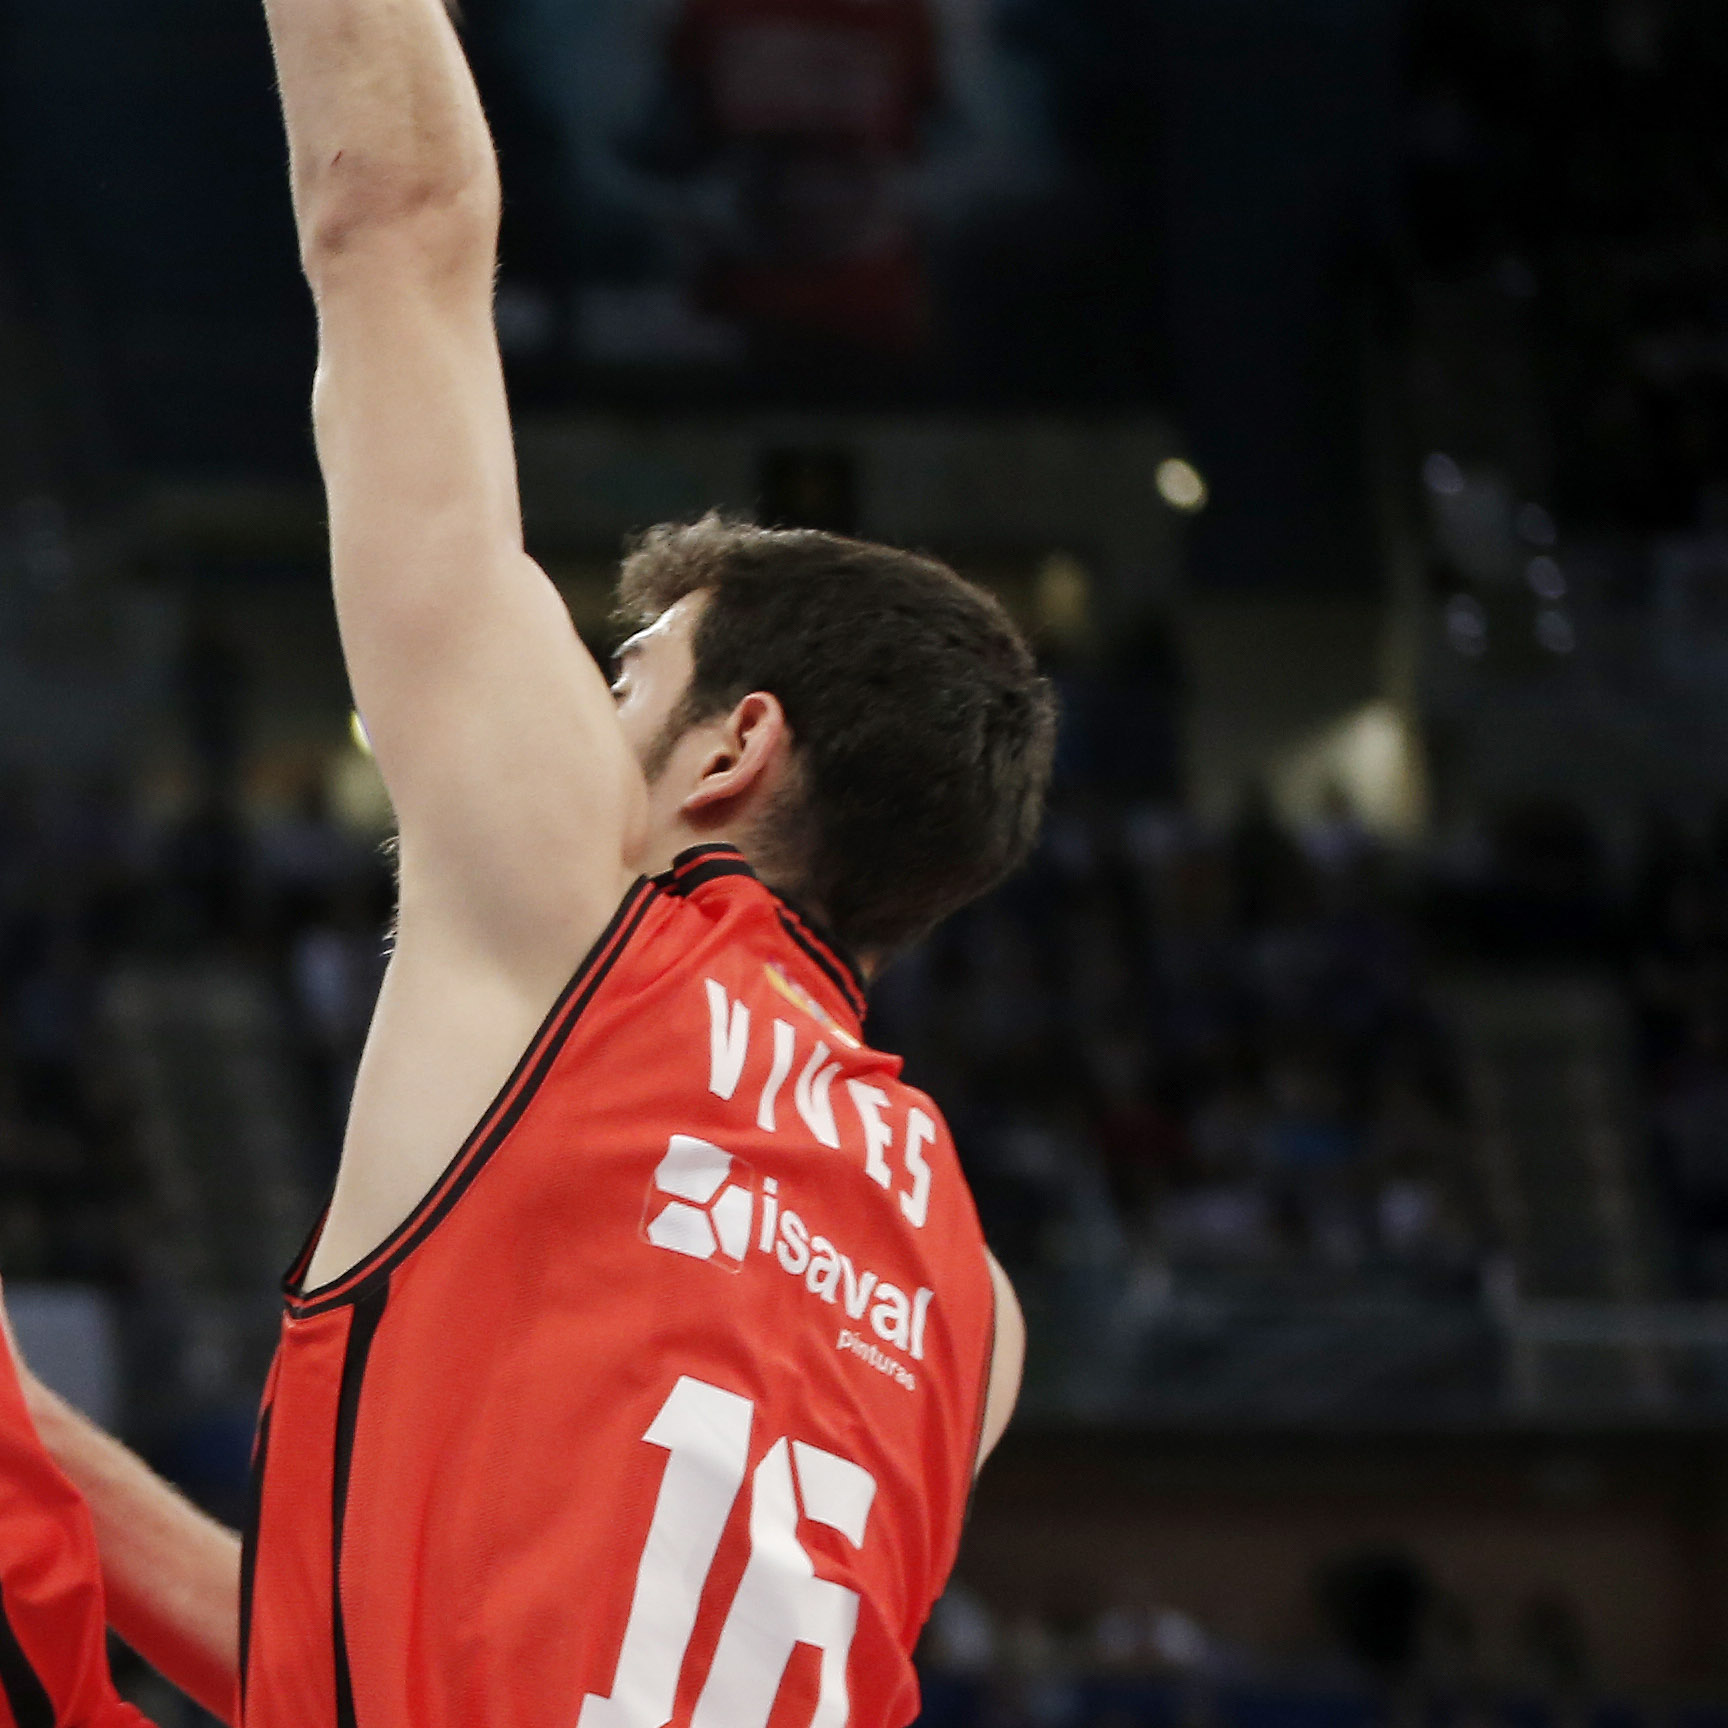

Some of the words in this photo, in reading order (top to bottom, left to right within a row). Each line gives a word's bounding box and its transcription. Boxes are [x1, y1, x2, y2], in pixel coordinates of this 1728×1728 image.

[704, 978, 937, 1229] VIVES
[758, 1177, 933, 1361] isaval
[836, 1326, 917, 1392] pinturas
